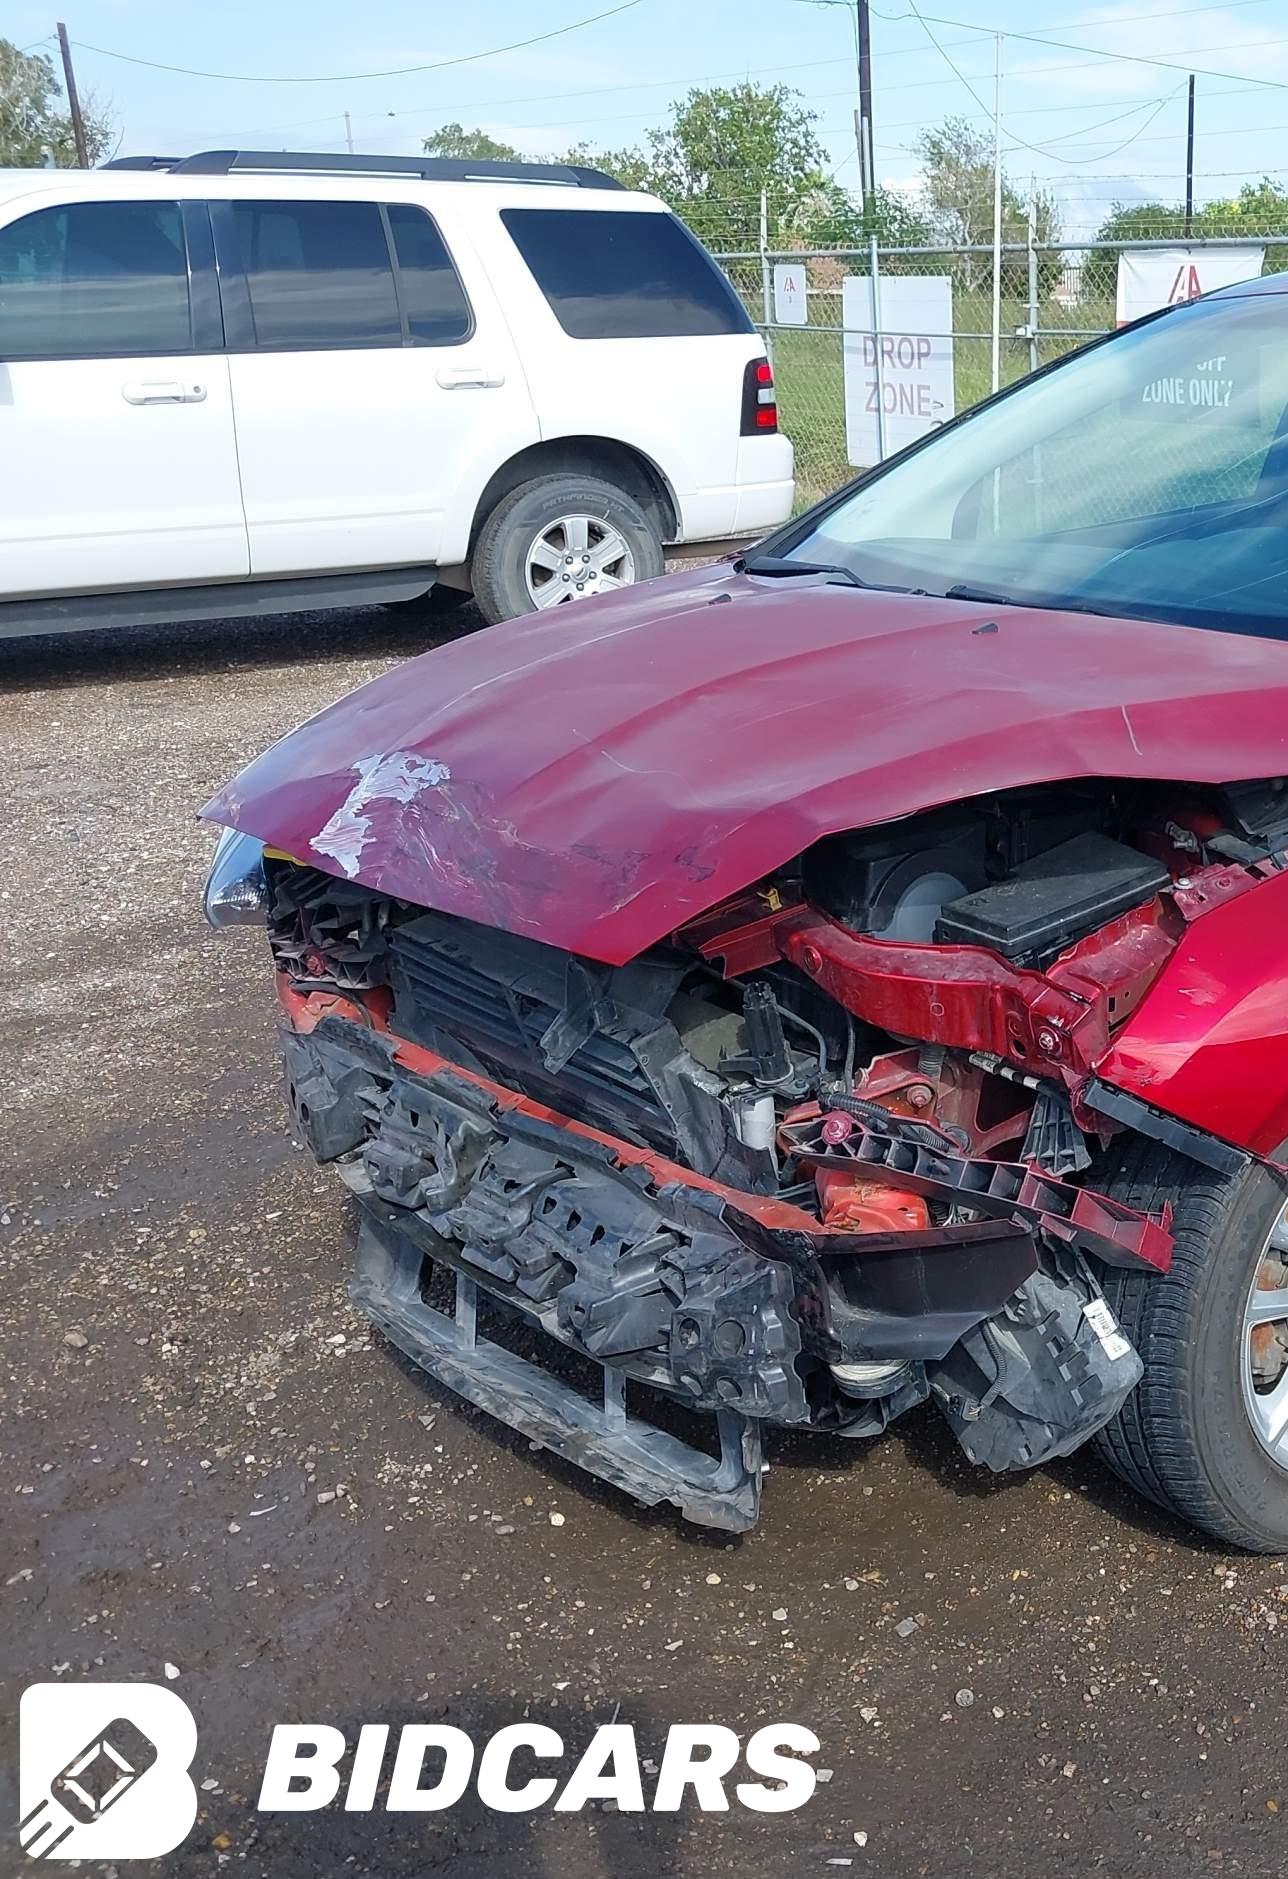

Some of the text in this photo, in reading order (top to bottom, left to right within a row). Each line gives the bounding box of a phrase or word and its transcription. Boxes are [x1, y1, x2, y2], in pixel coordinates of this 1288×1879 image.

[862, 335, 932, 370] DROP
[864, 381, 932, 417] ZONE
[1189, 378, 1233, 407] ONLY
